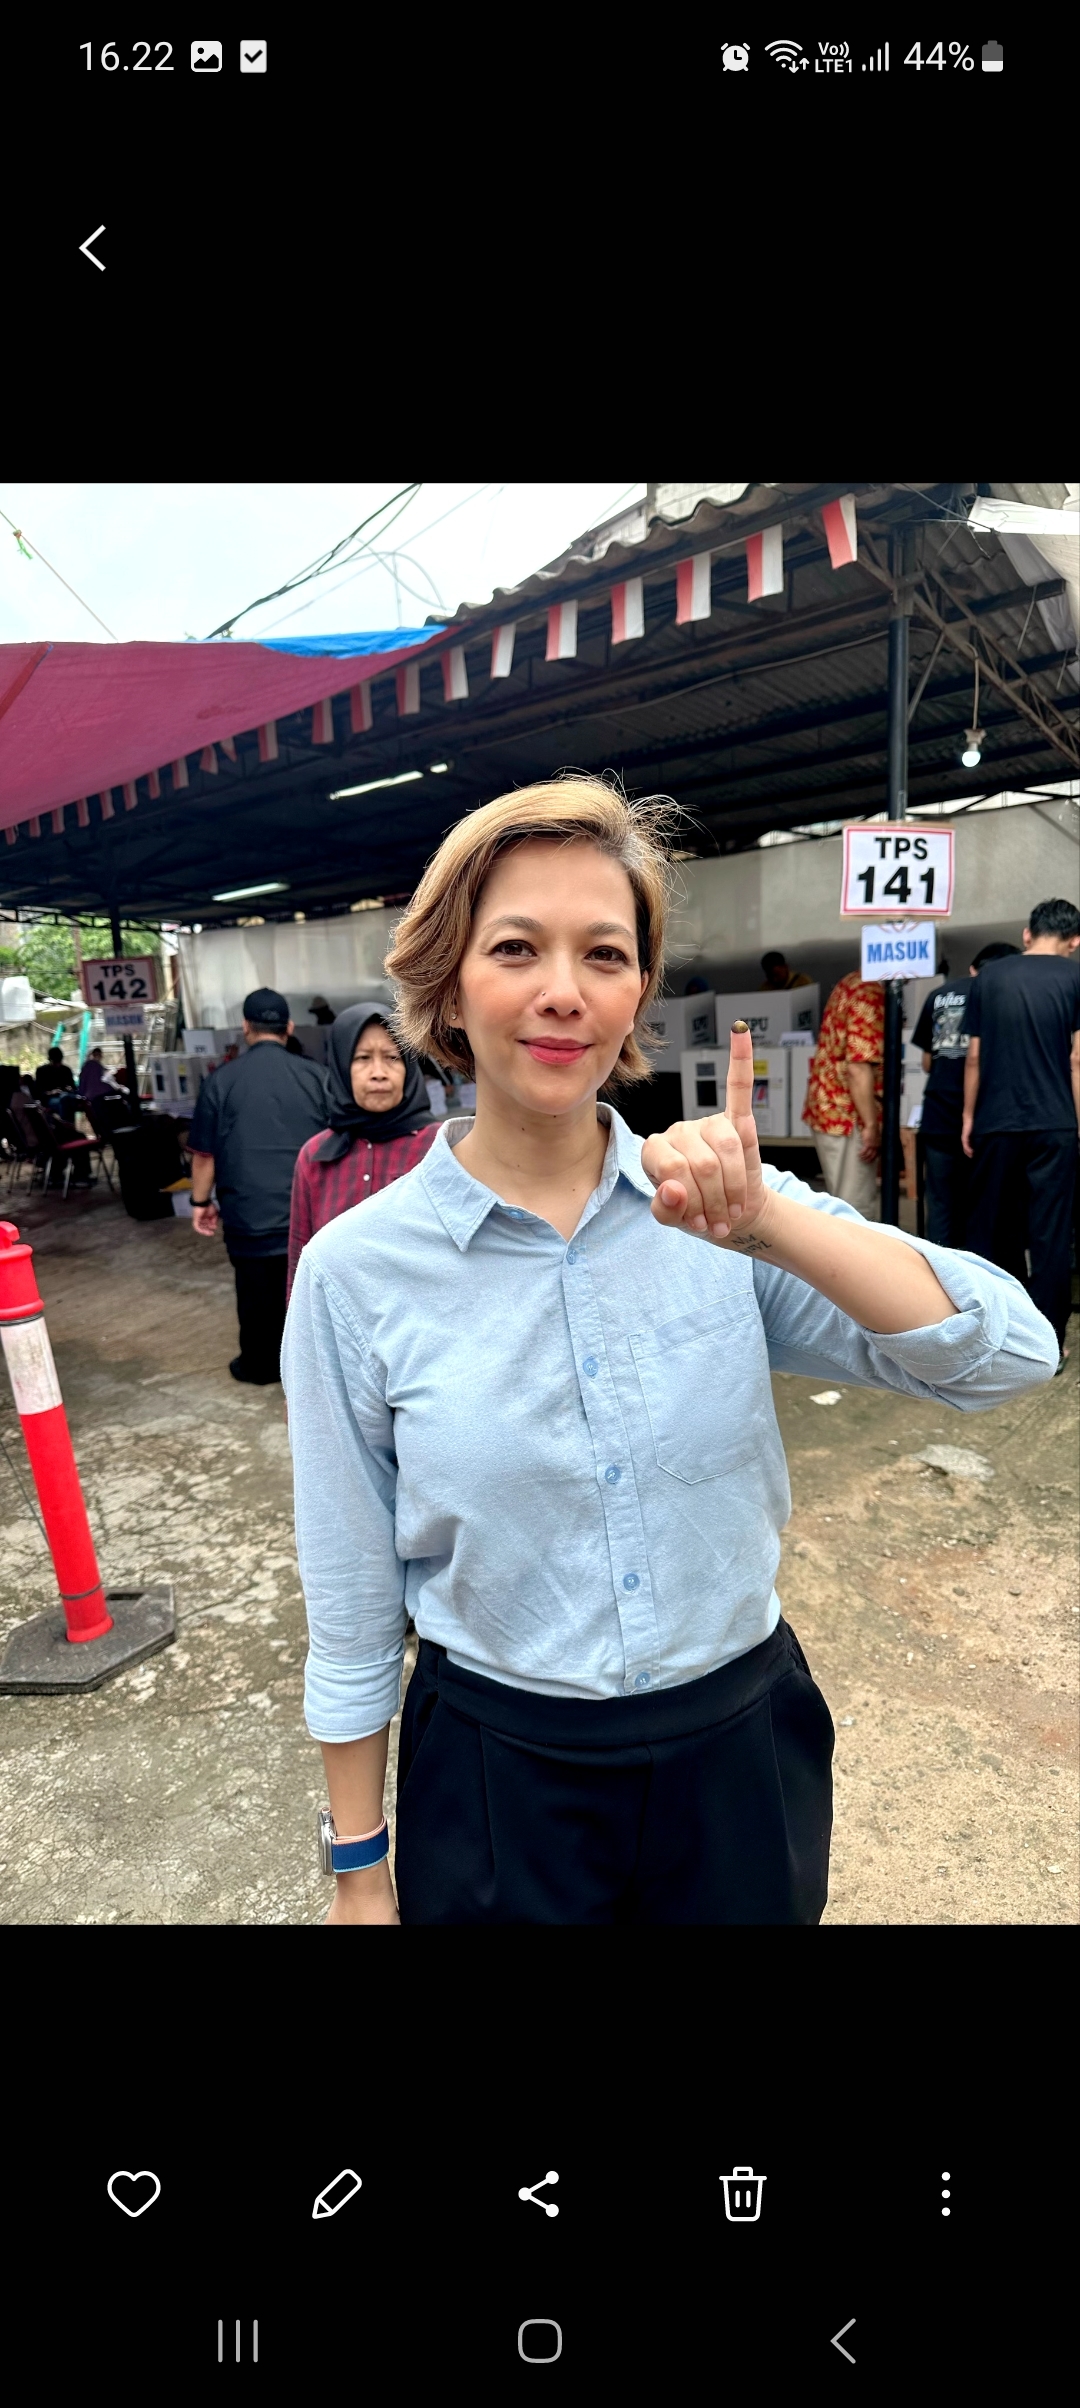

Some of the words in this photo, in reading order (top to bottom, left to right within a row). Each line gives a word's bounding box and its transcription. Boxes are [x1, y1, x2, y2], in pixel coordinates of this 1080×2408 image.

[874, 837, 928, 860] TPS
[857, 866, 935, 904] 141
[867, 940, 929, 963] MASUK
[100, 964, 135, 978] TPS
[93, 979, 148, 1001] 142
